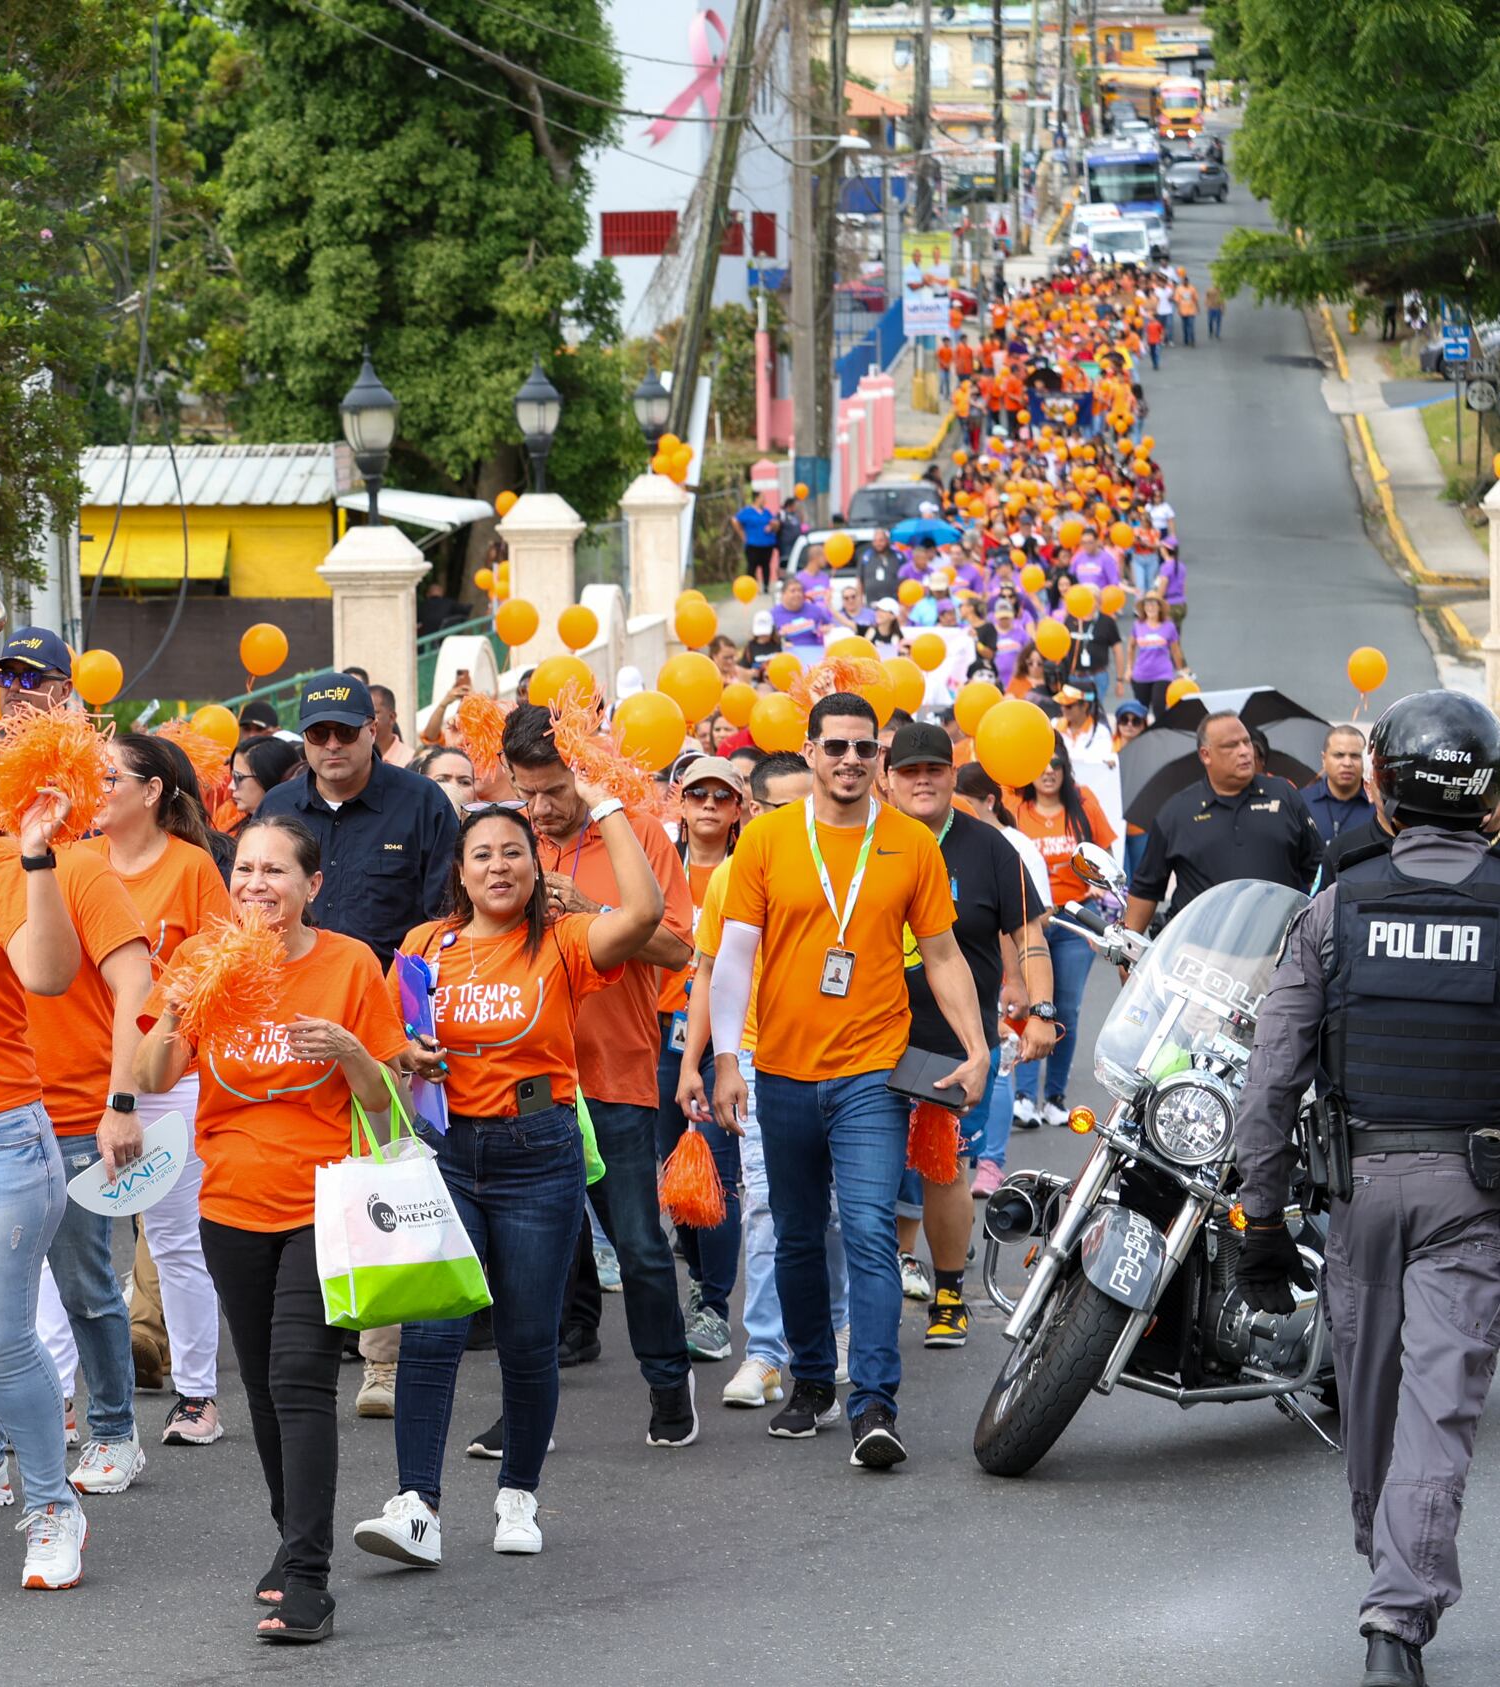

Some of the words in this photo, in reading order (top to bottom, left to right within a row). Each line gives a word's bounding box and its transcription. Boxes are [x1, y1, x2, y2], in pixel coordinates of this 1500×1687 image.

[308, 687, 345, 702] POLICIA
[1435, 748, 1472, 764] 33674
[1415, 770, 1483, 787] POLICIA
[1367, 921, 1480, 962] POLICIA
[457, 982, 520, 1004] TIEMPO
[435, 1006, 447, 1022] E
[453, 1001, 526, 1024] HABLAR
[102, 1151, 172, 1199] CIMA
[148, 1163, 178, 1187] HOSPITAL
[112, 1186, 146, 1211] MENONITA
[395, 1200, 436, 1211] SISTEMA
[411, 1518, 428, 1543] NY
